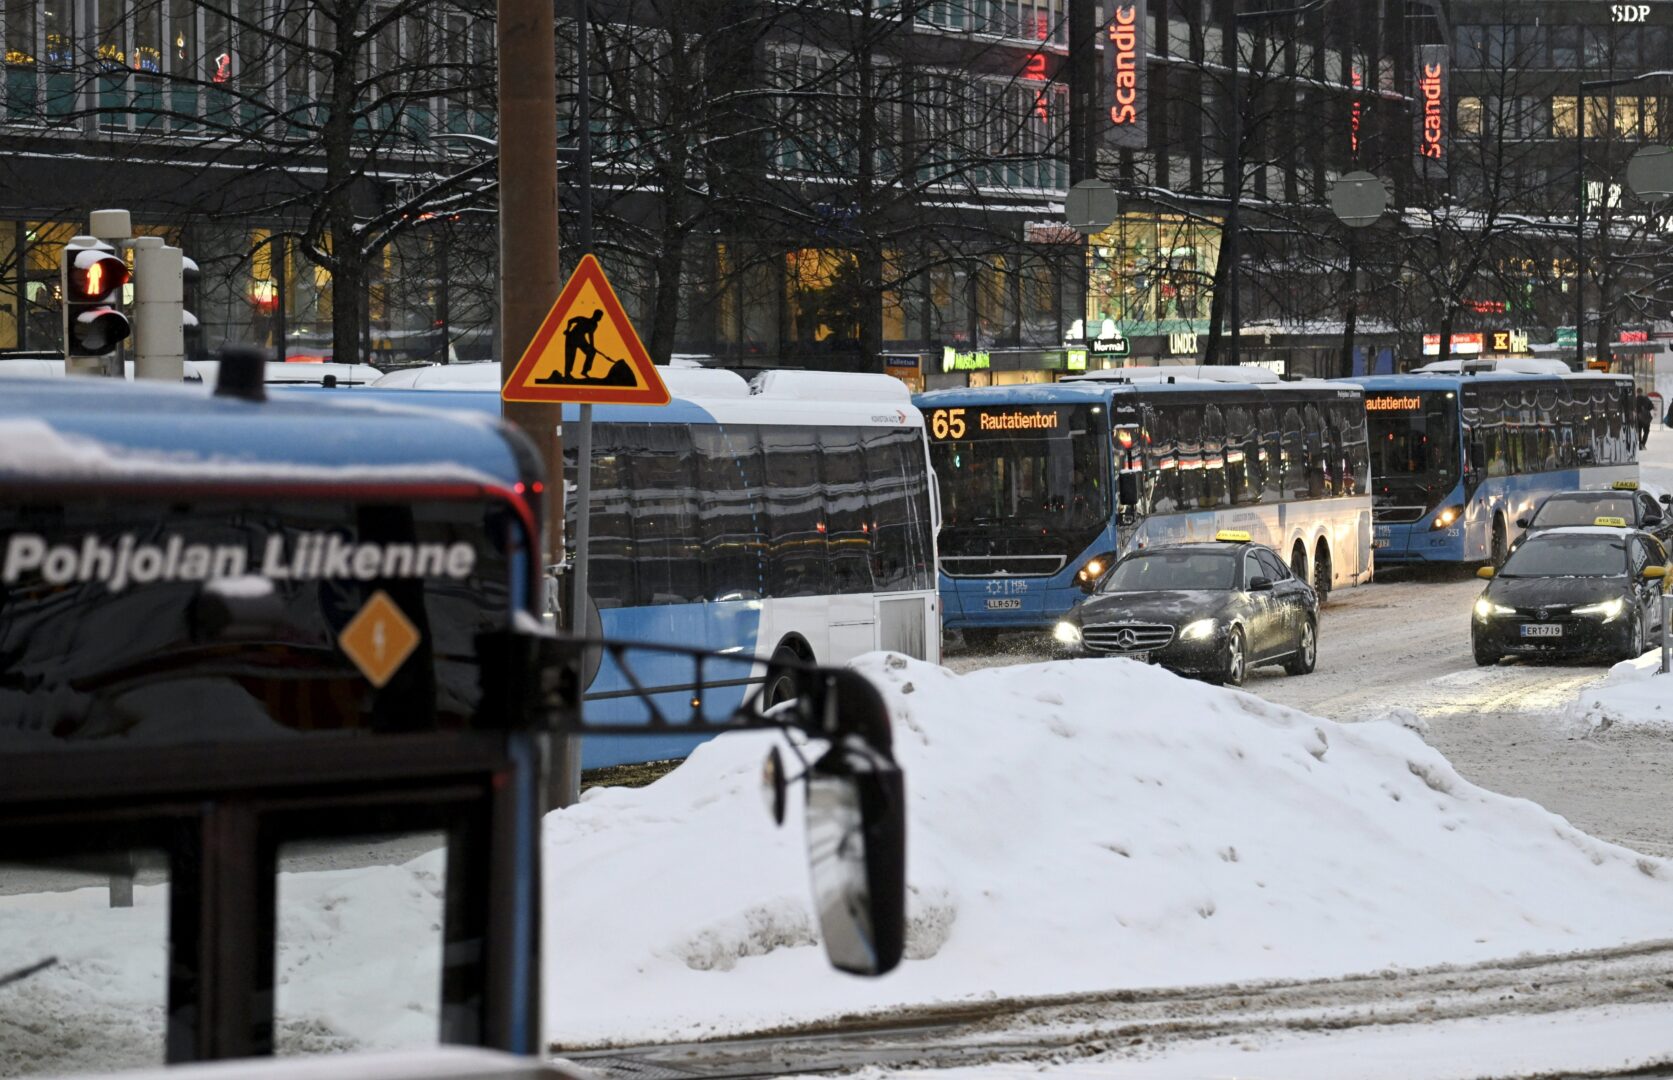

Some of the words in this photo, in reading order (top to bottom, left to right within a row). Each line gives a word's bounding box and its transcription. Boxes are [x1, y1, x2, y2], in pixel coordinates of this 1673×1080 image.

[1611, 4, 1651, 22] SDP
[1109, 4, 1136, 124] Scandic
[1420, 63, 1441, 158] Scandic
[1093, 340, 1125, 352] Normal
[1170, 333, 1198, 354] LINDEX
[1493, 333, 1508, 350] K
[1366, 395, 1421, 411] autatientori
[932, 408, 966, 440] 65
[980, 411, 1058, 430] Rautatientori
[1447, 528, 1459, 537] 253
[2, 533, 248, 592] Pohjolan
[261, 534, 477, 580] Liikenne
[988, 599, 1020, 608] LLR-579
[1526, 625, 1561, 636] ERT-719
